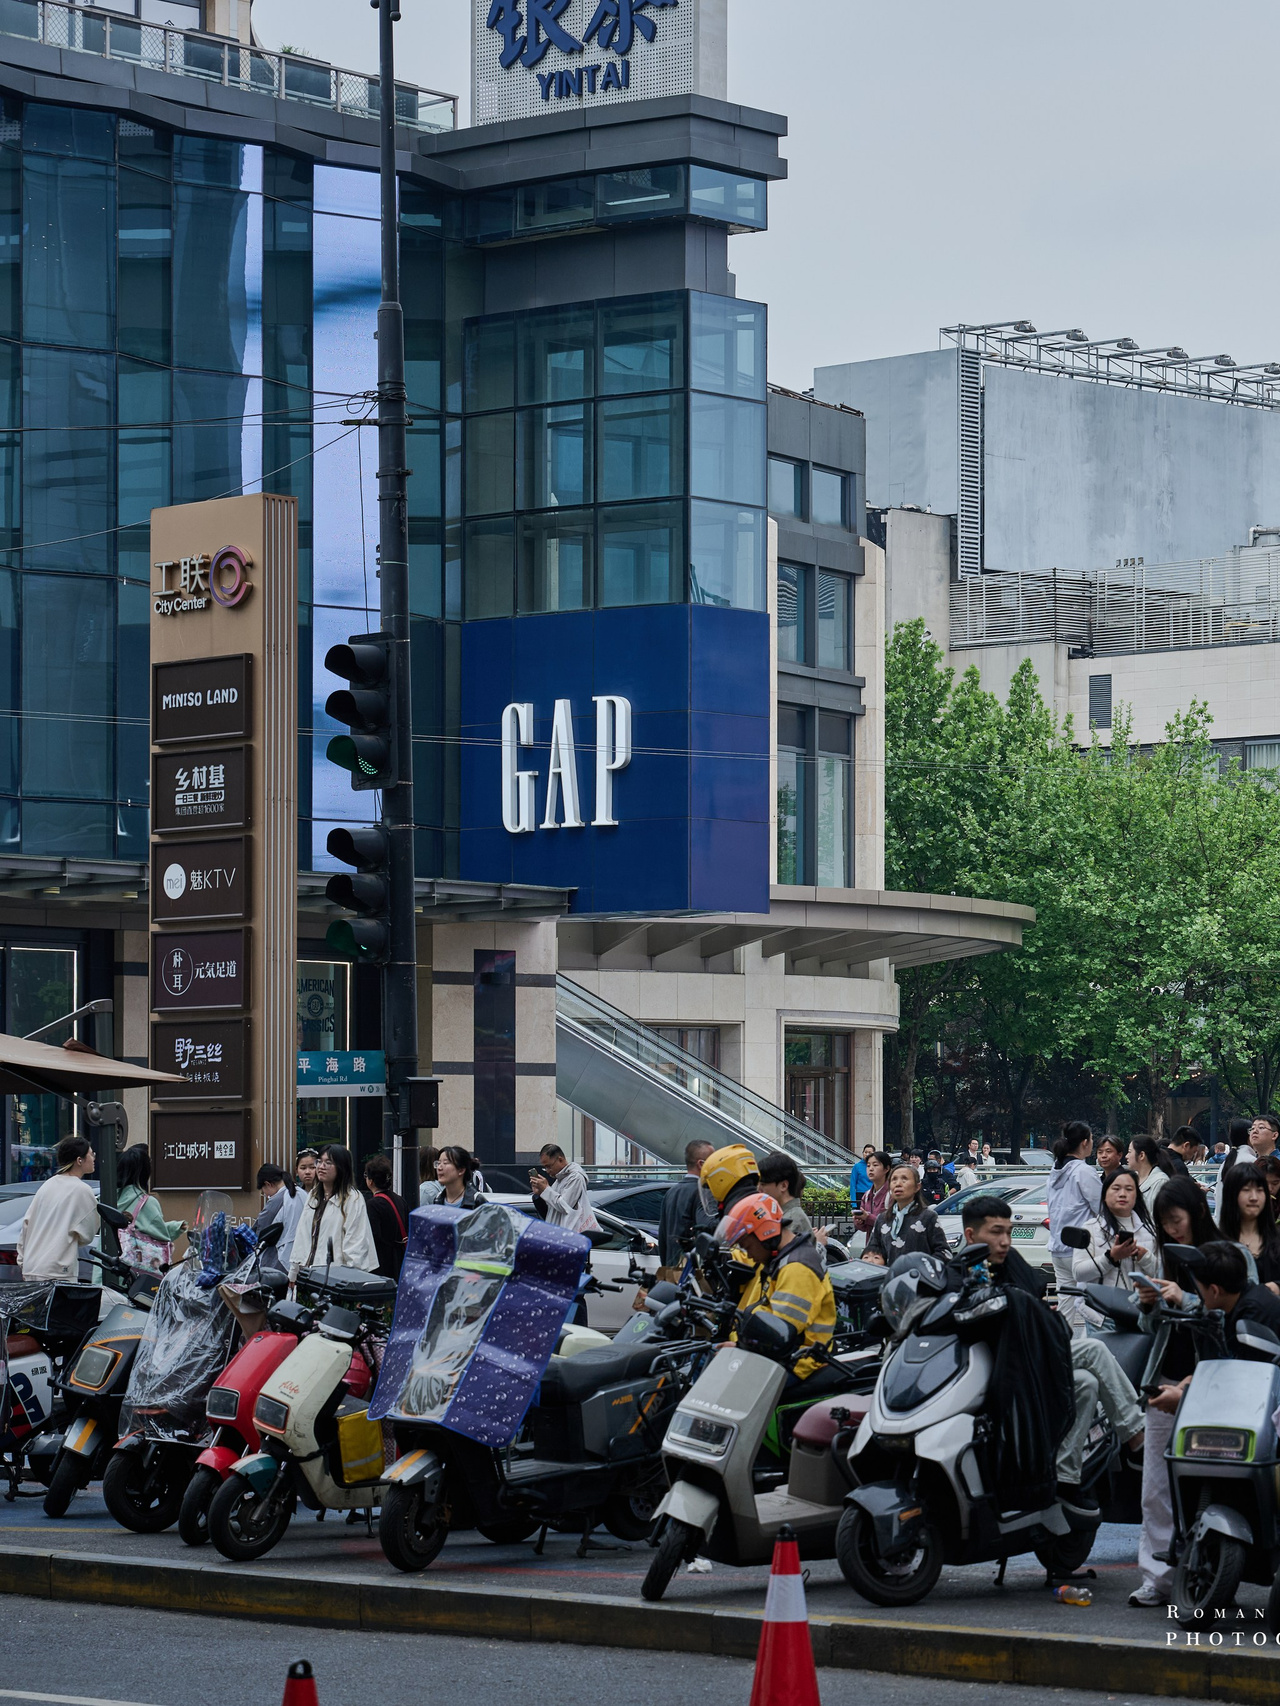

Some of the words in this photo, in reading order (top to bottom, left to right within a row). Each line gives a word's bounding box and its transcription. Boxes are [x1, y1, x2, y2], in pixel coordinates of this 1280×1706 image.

[536, 59, 630, 101] YINTAI
[152, 552, 206, 596] 工联
[153, 600, 174, 615] City
[173, 596, 207, 612] Center
[162, 691, 202, 711] MINISO
[206, 687, 239, 705] LAND
[501, 695, 632, 834] GAP
[174, 763, 225, 792] 乡村基
[166, 873, 183, 890] mei
[189, 867, 237, 891] 魅KTV
[175, 1038, 223, 1069] 野三丝
[297, 1056, 366, 1074] 平海路
[318, 1076, 339, 1084] Pinghai
[164, 1141, 211, 1159] 江边城外
[690, 1398, 710, 1408] AIMA
